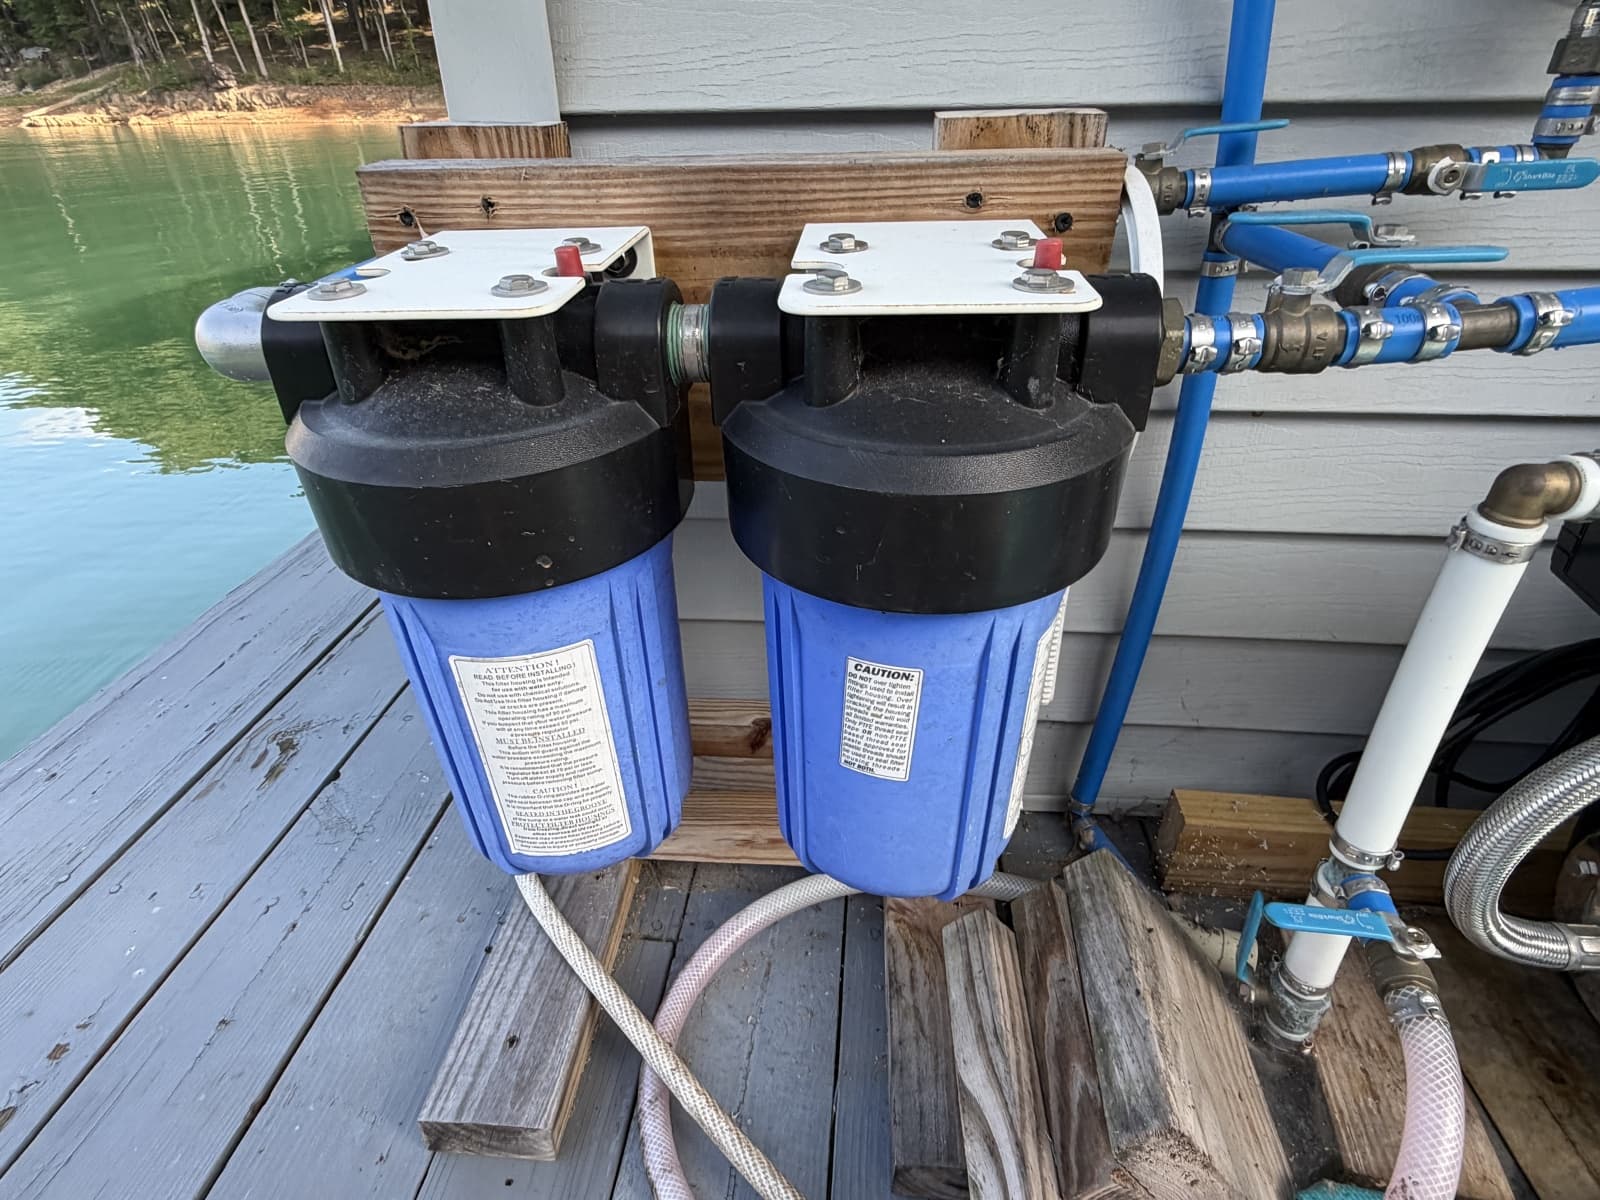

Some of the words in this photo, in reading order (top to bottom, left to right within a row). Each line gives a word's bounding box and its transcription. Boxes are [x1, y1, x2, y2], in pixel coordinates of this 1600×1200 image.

[485, 661, 553, 674] ATTENTION
[854, 663, 914, 681] CAUTION:
[543, 671, 570, 681] intended
[858, 675, 872, 683] NOT
[522, 688, 550, 696] chemical
[563, 685, 587, 695] damage
[847, 685, 863, 694] filter
[869, 685, 886, 693] used
[846, 699, 871, 711] cracking
[884, 708, 911, 717] housing
[566, 708, 592, 719] pressure
[858, 721, 873, 729] PTFE
[866, 737, 889, 745] thread
